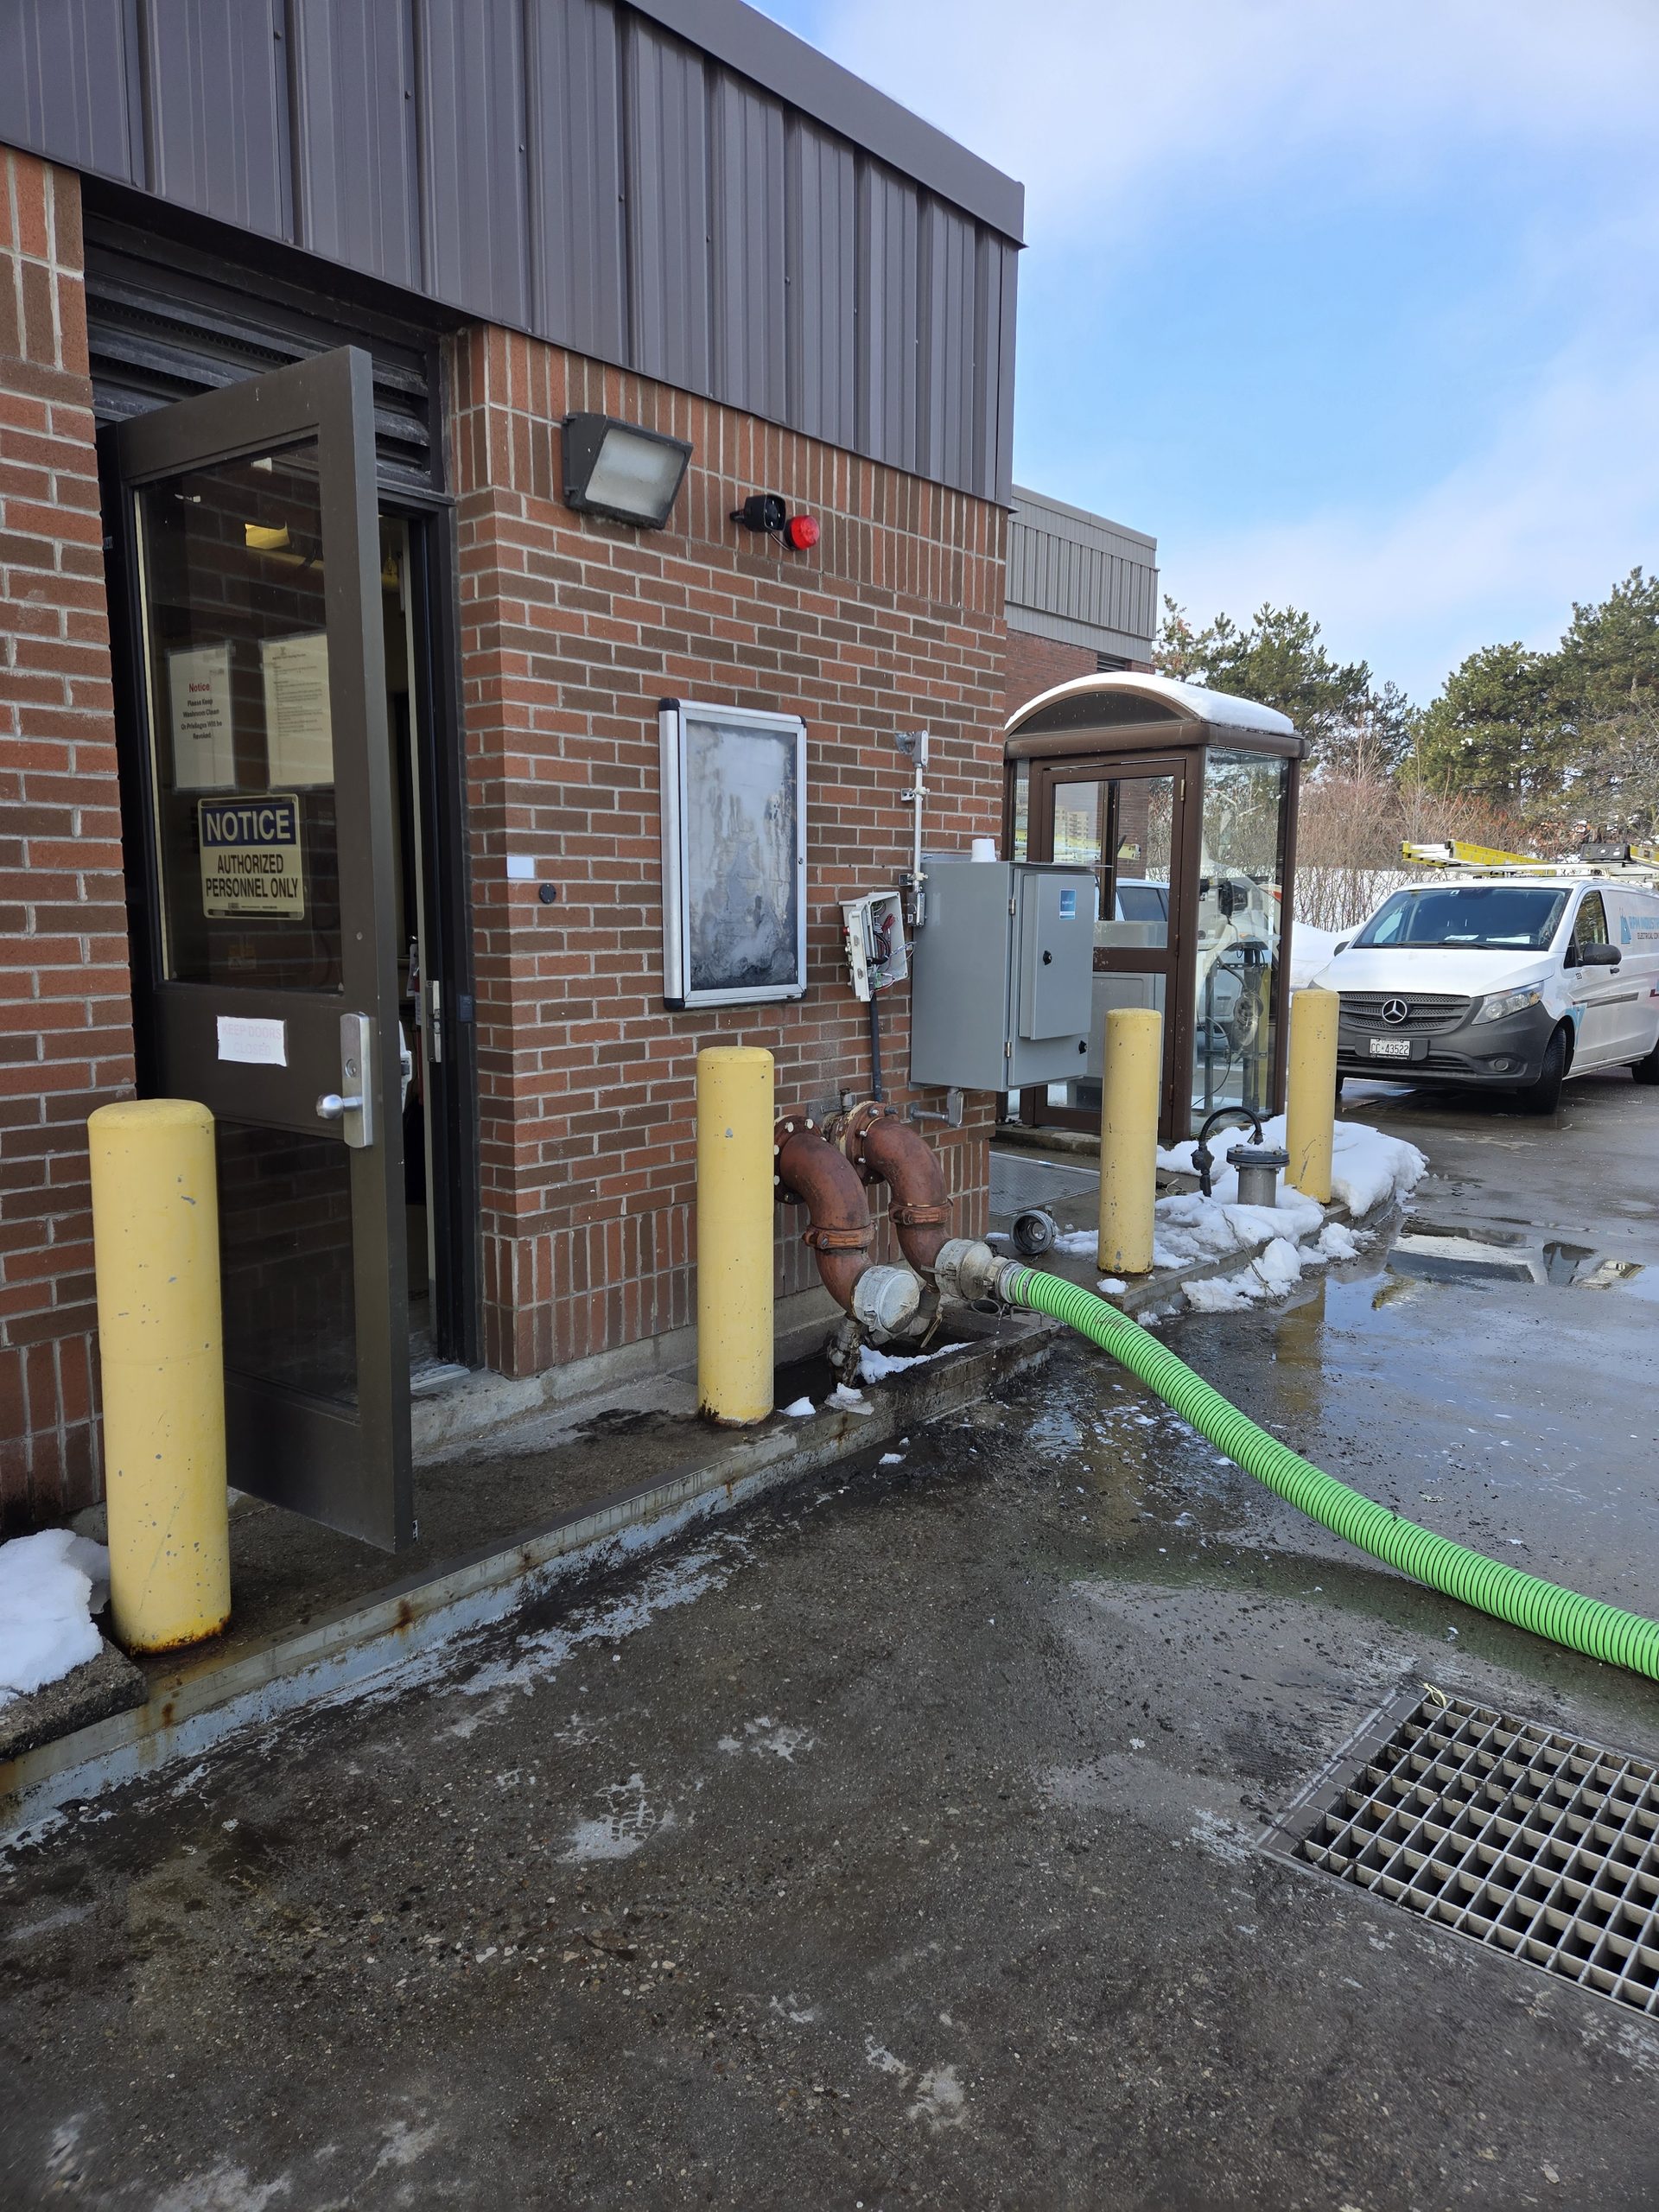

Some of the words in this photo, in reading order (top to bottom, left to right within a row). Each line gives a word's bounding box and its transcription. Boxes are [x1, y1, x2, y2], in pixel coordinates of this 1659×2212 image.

[188, 683, 210, 693] Notice
[206, 810, 290, 842] NOTICE
[218, 854, 283, 874] AUTHORIZED
[206, 878, 269, 898] PERSONNEL
[270, 877, 298, 898] ONLY
